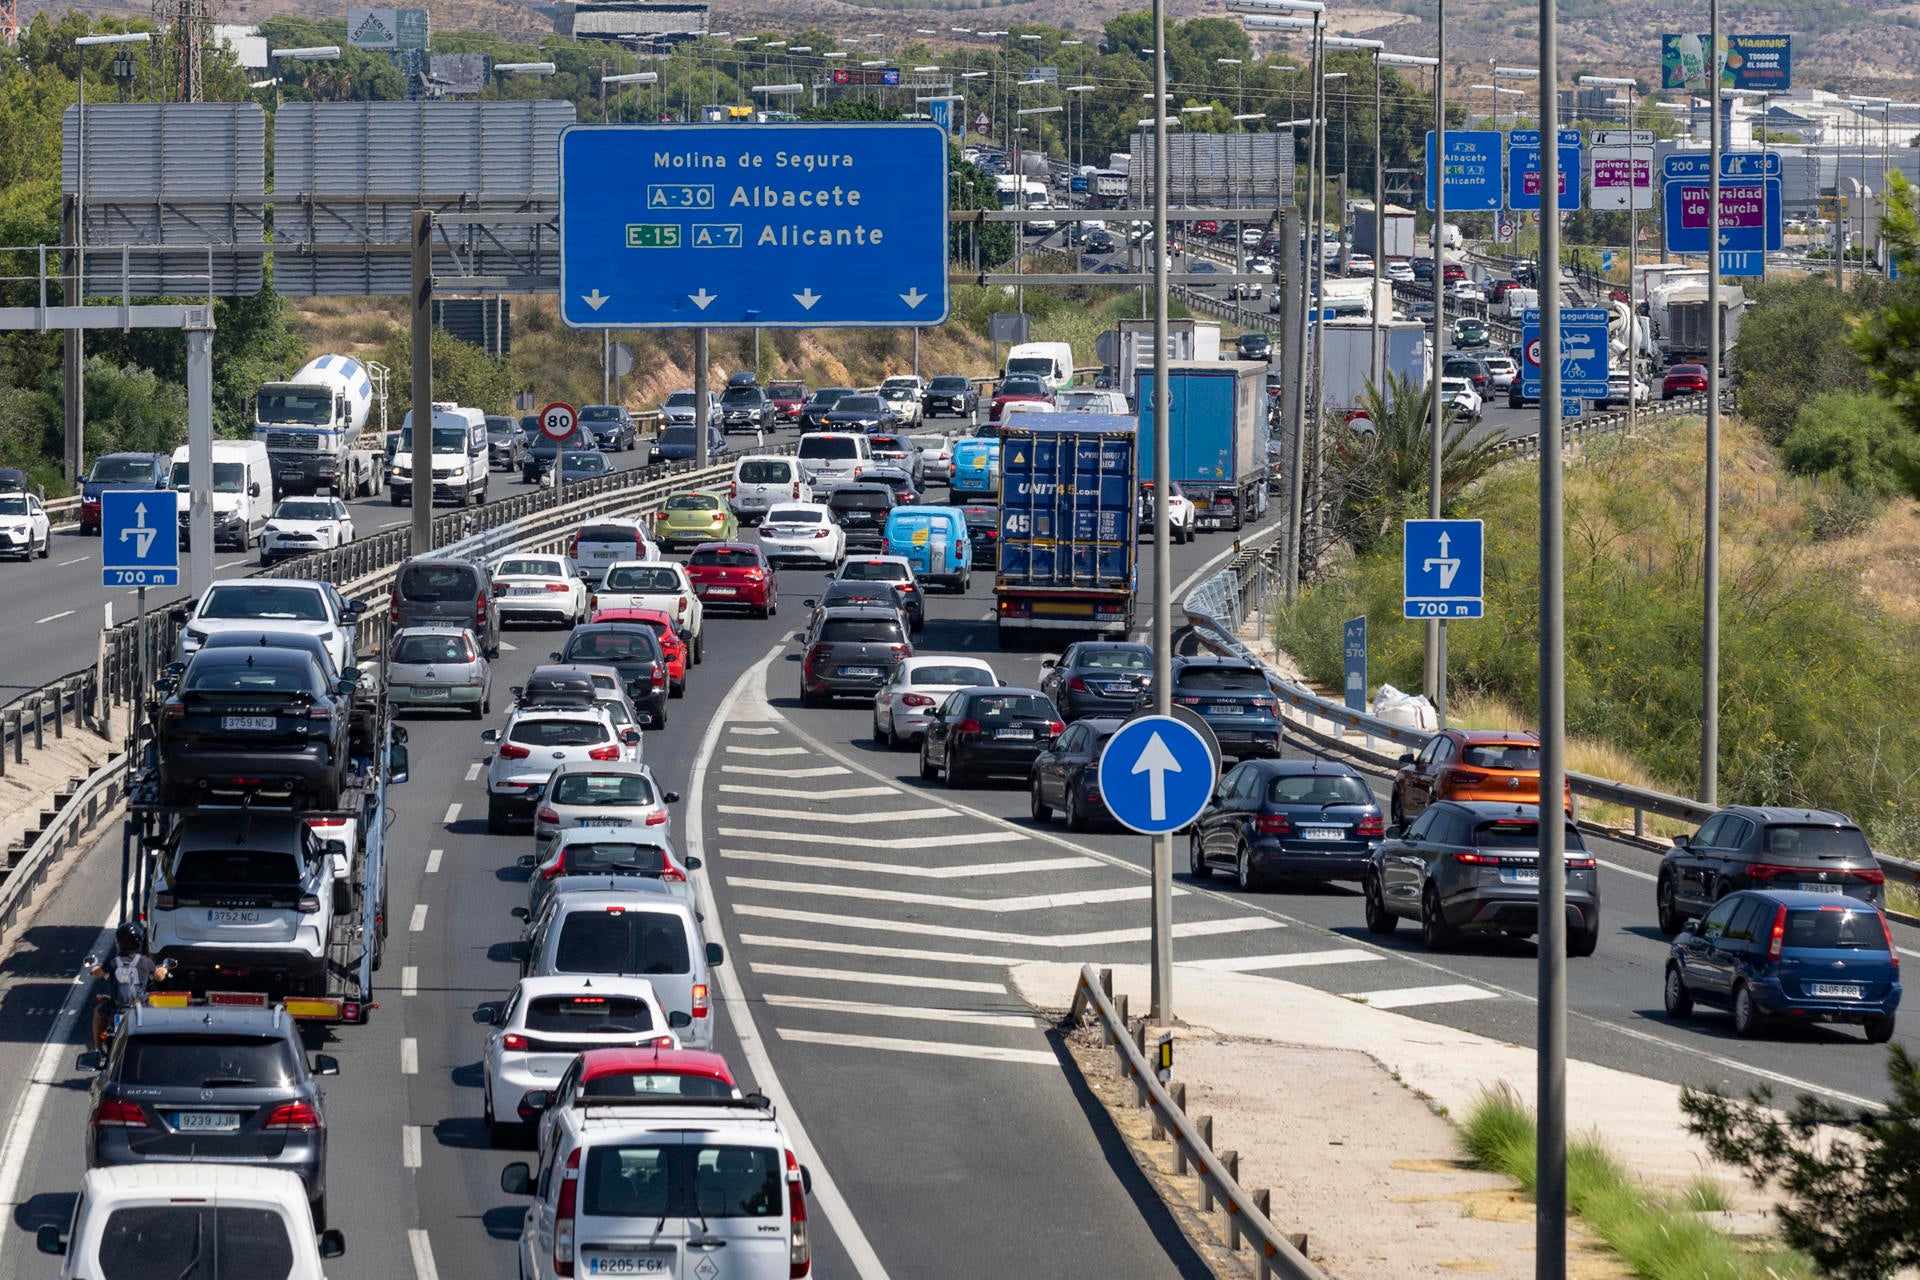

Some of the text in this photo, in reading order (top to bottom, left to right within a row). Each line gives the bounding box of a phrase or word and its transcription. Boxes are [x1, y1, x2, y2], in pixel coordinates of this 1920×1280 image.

[653, 151, 854, 172] Molina de Segura
[1444, 154, 1487, 162] Albacete
[1595, 160, 1649, 168] universdad
[1671, 161, 1694, 171] 200
[1614, 170, 1646, 178] Mucia
[651, 186, 862, 207] A-30 Albacete
[1683, 188, 1762, 200] univrsidad
[1688, 204, 1705, 214] de
[628, 225, 884, 246] E-15 A-7 Alicante
[1561, 312, 1604, 320] seguridad
[548, 415, 570, 427] 80
[1006, 515, 1030, 532] 45
[116, 571, 165, 583] 700 m
[1417, 602, 1469, 615] 700 m
[1346, 627, 1363, 637] A-7
[1346, 649, 1365, 657] 570
[228, 717, 274, 728] 3759 NCJ
[213, 911, 260, 921] 3752 NCJ
[183, 1114, 236, 1126] 9239 JJR
[600, 1258, 664, 1272] 6205 FGX
